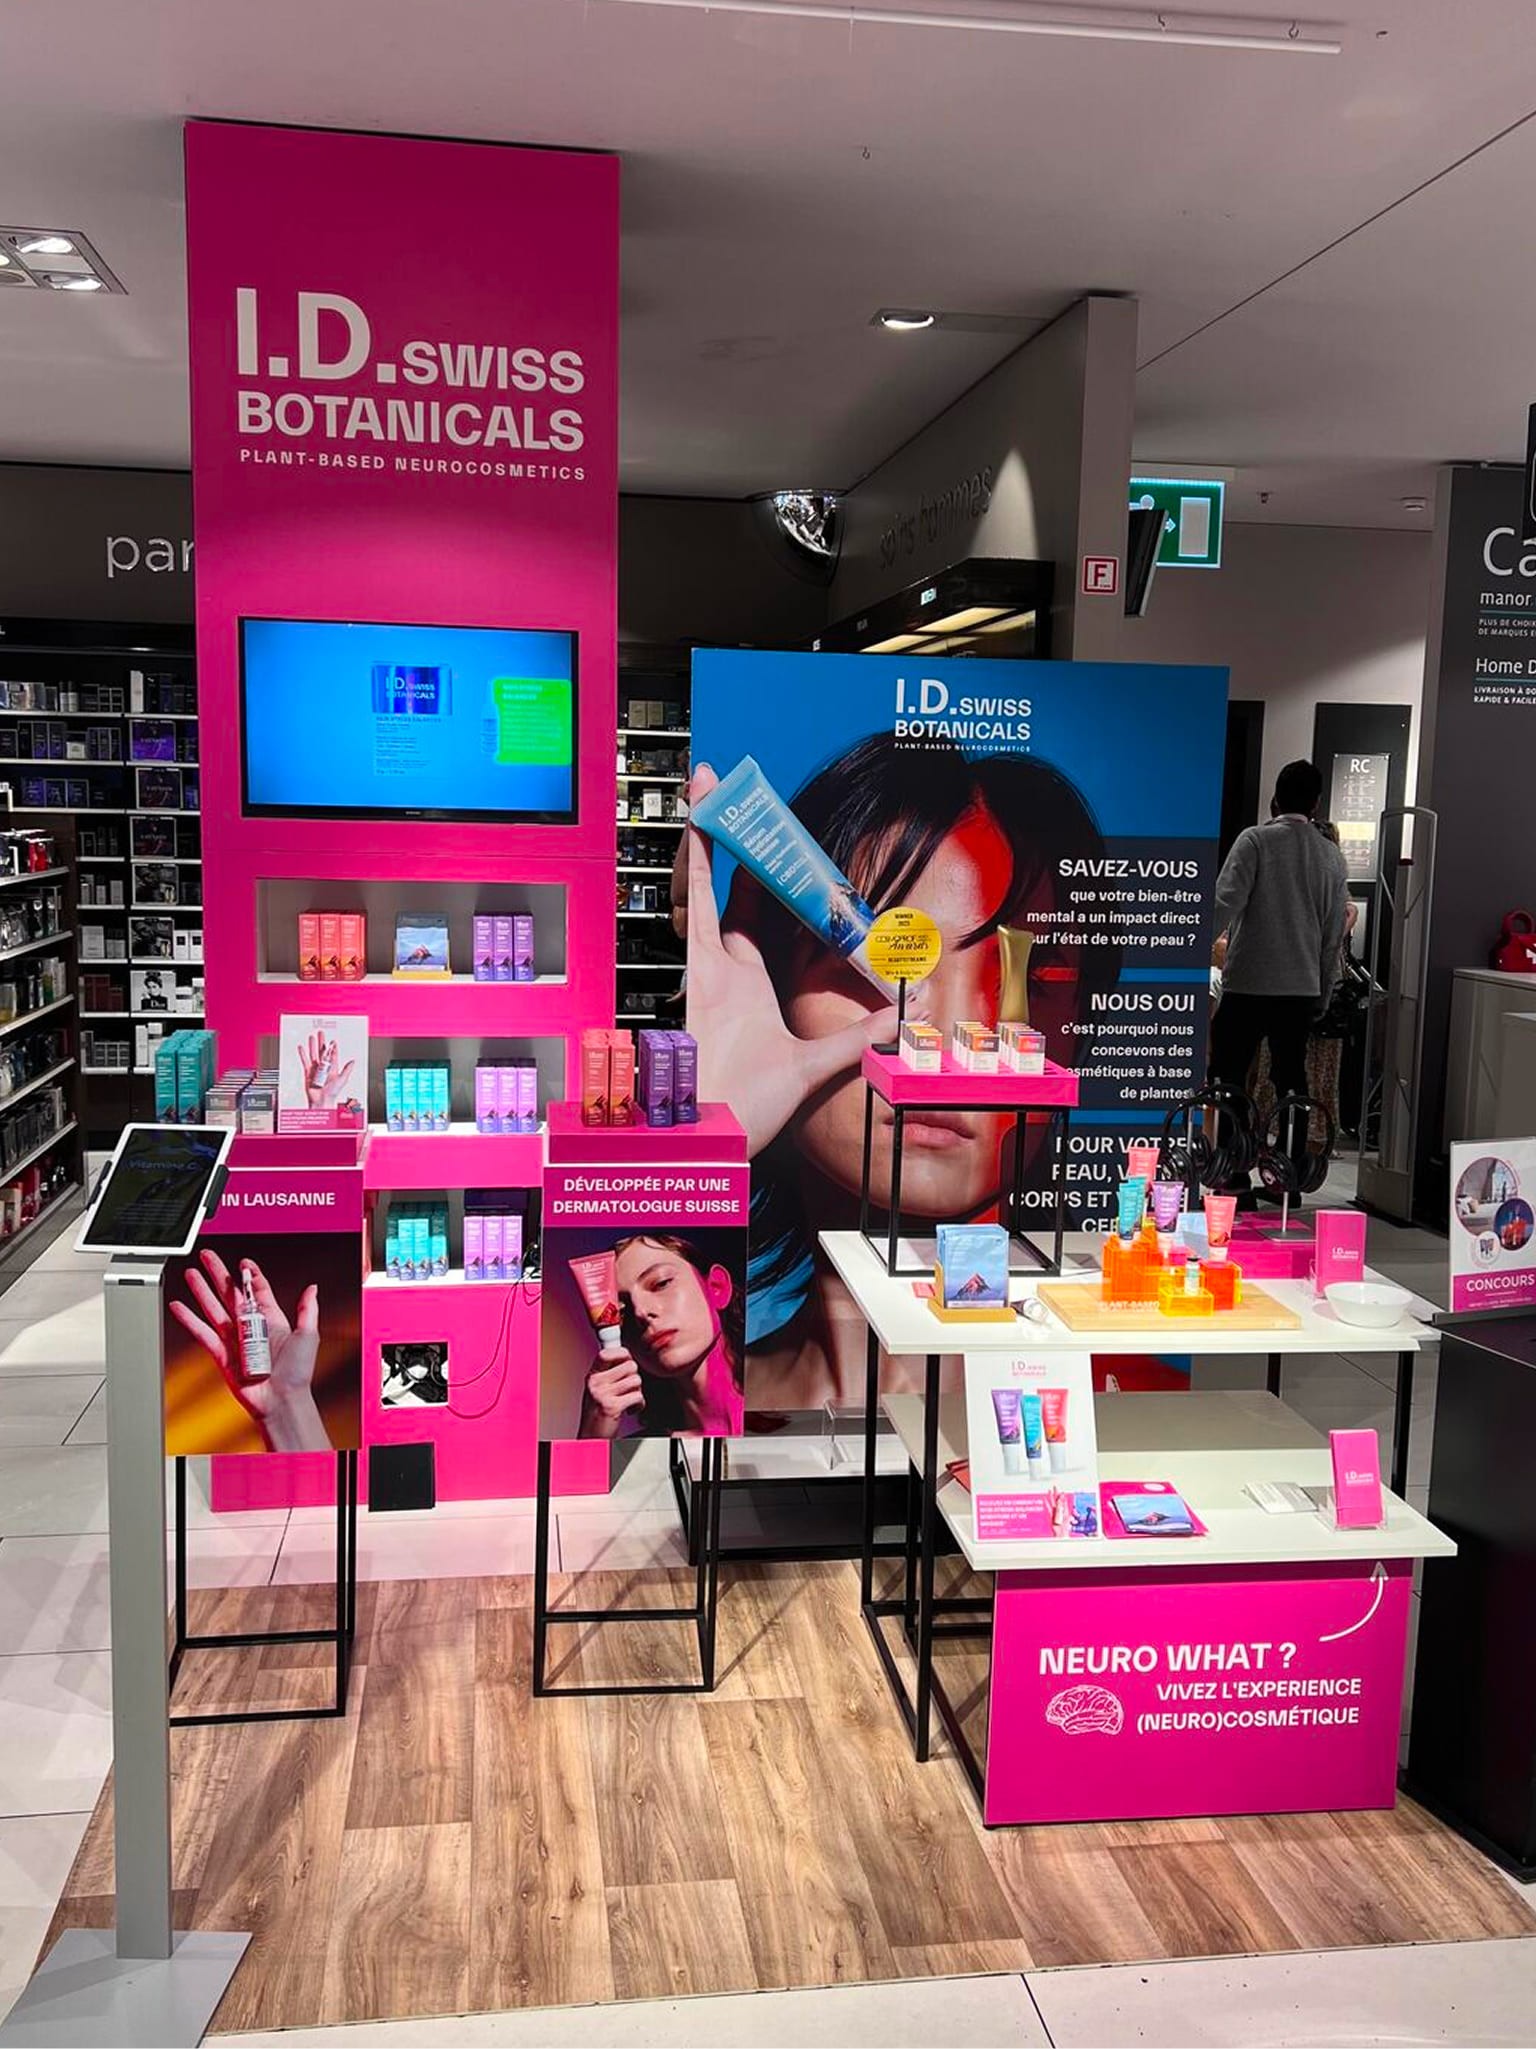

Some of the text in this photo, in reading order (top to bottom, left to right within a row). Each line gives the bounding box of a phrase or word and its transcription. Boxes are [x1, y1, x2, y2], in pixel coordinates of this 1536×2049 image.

[237, 390, 585, 451] BOTANICALS
[240, 449, 586, 481] PLANT-BASED NEUROCOSMETICS
[1094, 564, 1107, 587] F
[1490, 628, 1528, 637] MARQUES
[1476, 657, 1523, 674] Home
[1474, 686, 1516, 694] LIVRAISON
[1474, 695, 1503, 704] RAPIDE
[895, 720, 1031, 741] BOTANICALS
[894, 742, 951, 751] PLANT-BASED
[1350, 758, 1371, 774] RC
[1059, 858, 1199, 879] SAVEZ-VOUS
[1070, 890, 1202, 904] que votre bien-être
[1027, 910, 1201, 928] mental a un impact direct
[1053, 932, 1089, 945] l'état
[1091, 933, 1109, 945] de
[1111, 934, 1148, 946] votre
[1150, 936, 1184, 950] peau
[1188, 933, 1196, 946] ?
[1091, 993, 1195, 1012] NOUS OUI
[1061, 1022, 1194, 1039] c'est pourquoi nous
[1091, 1044, 1193, 1057] concevons des
[1147, 1065, 1156, 1078] à
[1159, 1066, 1192, 1078] base
[1120, 1086, 1137, 1099] de
[564, 1175, 731, 1192] DÉVELOPPÉE PAR UNE
[222, 1192, 336, 1207] IN LAUSANNE
[553, 1199, 740, 1214] DERMATOLOGUE SUISSE
[1087, 1191, 1112, 1208] ET
[1466, 1273, 1536, 1292] CONCOURS
[1039, 1641, 1297, 1676] NEURO WHAT ?
[1156, 1679, 1362, 1701] VIVEZ L'EXPERIENCE
[1137, 1706, 1360, 1735] (NEURO)COSMÉTIQUE
